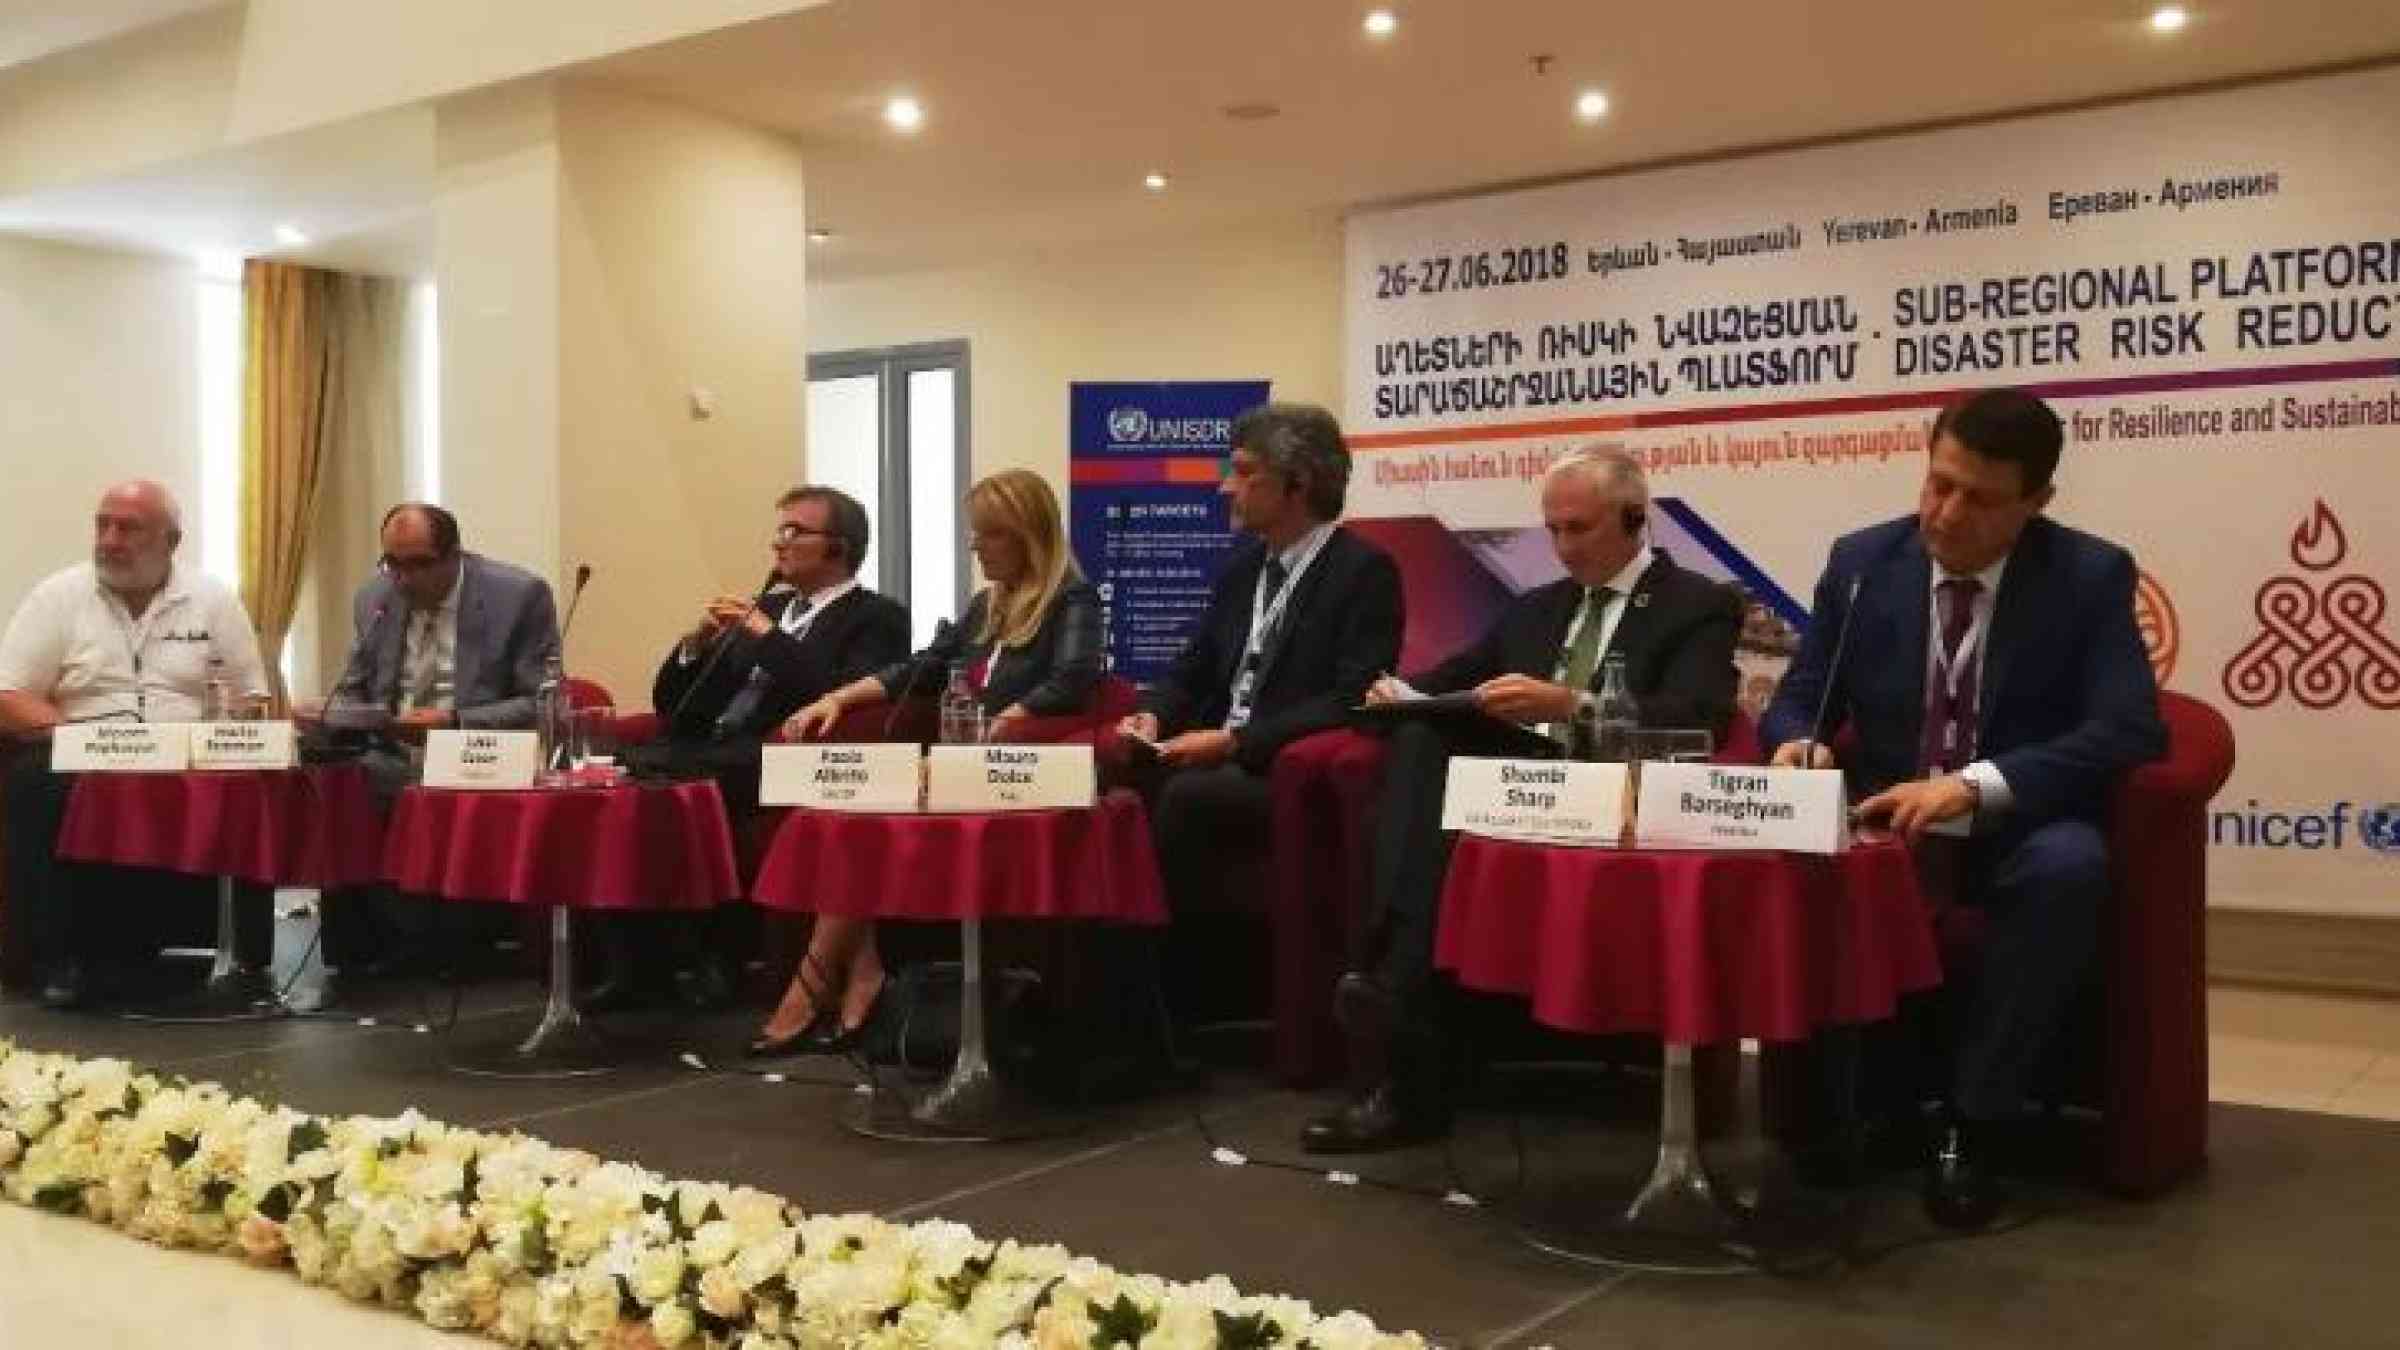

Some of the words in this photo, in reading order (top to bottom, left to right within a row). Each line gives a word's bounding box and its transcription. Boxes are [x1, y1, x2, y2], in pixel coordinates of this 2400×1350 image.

[2048, 187, 2138, 222] Ереван
[2158, 171, 2280, 211] Армения
[1822, 212, 1907, 247] Yerevan
[1925, 201, 2018, 233] Armenia
[1376, 242, 1570, 299] 26-27.06.2018
[1894, 264, 2178, 326] SUB-REGIONAL
[2191, 238, 2400, 300] PLATFOR
[1896, 321, 2080, 376] DISASTER
[2111, 311, 2206, 359] RISK
[2237, 293, 2400, 349] REDUC
[1150, 418, 1232, 442] UNISDR
[2071, 409, 2103, 441] for
[2109, 403, 2223, 438] Resilience
[2231, 398, 2276, 432] and
[1500, 764, 1567, 786] Shombi
[1708, 770, 1769, 794] Tigran
[1504, 787, 1556, 809] Sharp
[1680, 792, 1794, 821] Barseghyan
[2213, 799, 2354, 850] nicef
